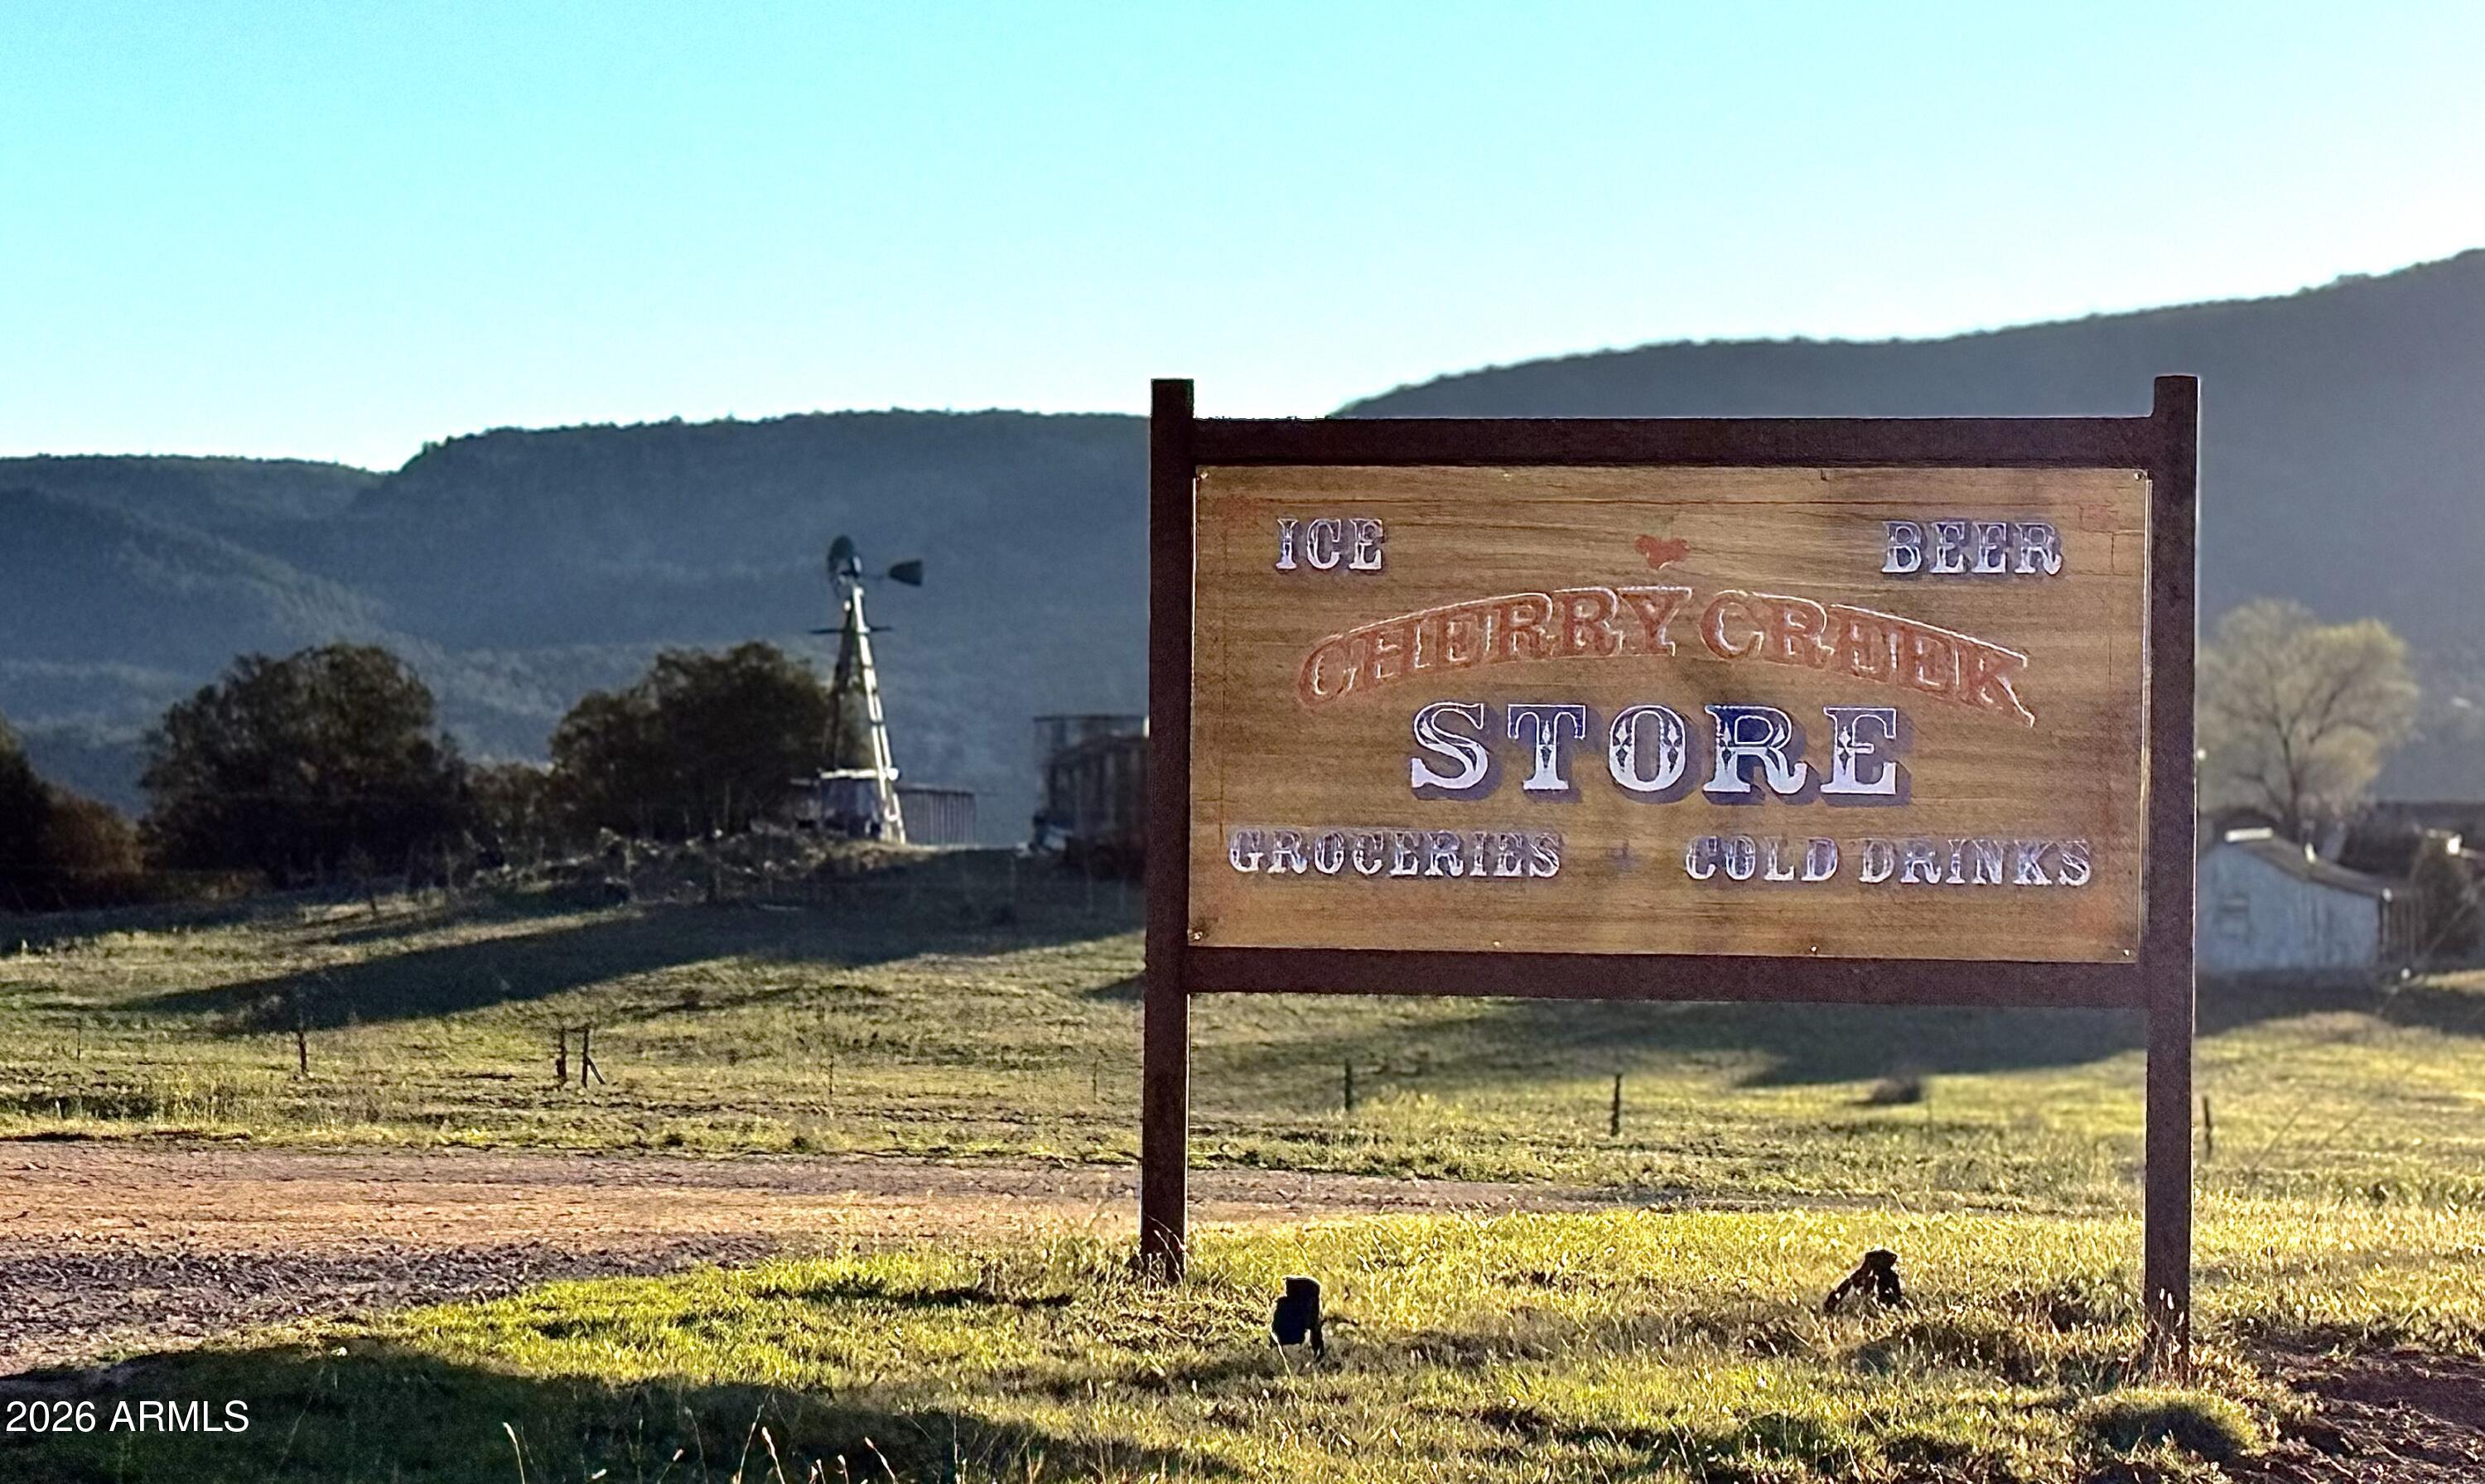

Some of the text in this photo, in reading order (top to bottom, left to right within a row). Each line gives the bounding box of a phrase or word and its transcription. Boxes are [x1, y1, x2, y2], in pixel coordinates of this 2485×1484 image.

[1275, 517, 1385, 571] ICE
[1880, 520, 2064, 575] BEER
[1297, 585, 2034, 727] CHERRY CREEK
[1411, 701, 1898, 795] STORE
[1228, 828, 1562, 879] GROCERIES
[1684, 835, 2093, 888] COLD DRINKS
